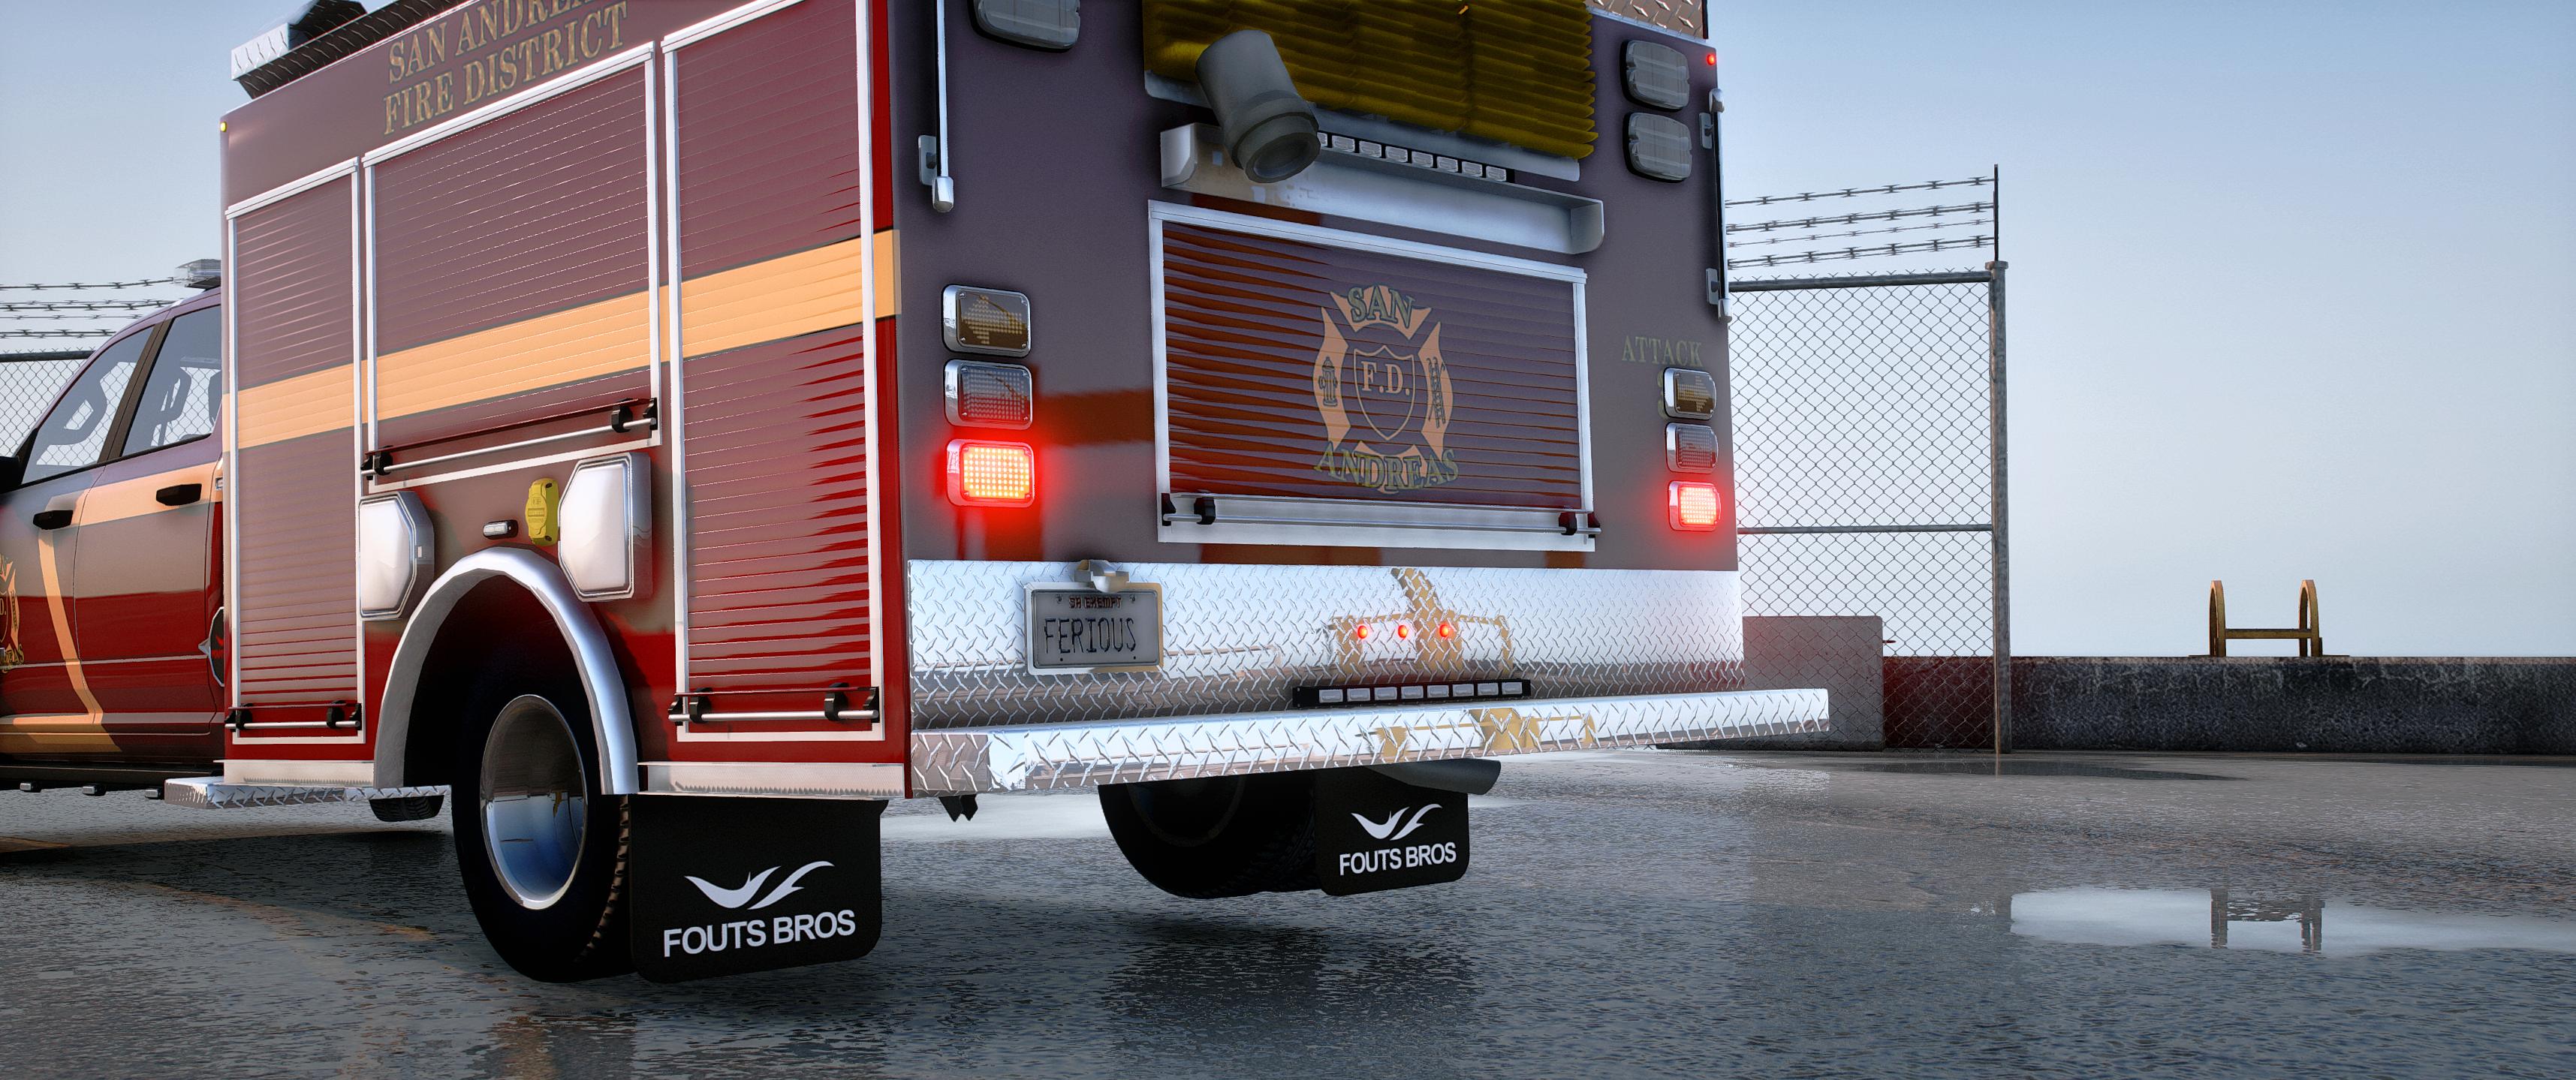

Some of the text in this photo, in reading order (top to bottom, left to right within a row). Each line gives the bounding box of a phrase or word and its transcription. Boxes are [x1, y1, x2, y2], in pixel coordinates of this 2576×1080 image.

[383, 2, 628, 135] FIRE DISTRICT
[388, 21, 447, 84] SAN
[1347, 284, 1415, 329] SAN
[1622, 335, 1703, 367] ATTACK
[1360, 360, 1410, 396] F.D.
[1315, 441, 1459, 489] ANDREAS
[1044, 617, 1136, 654] FERIOUS
[1339, 842, 1457, 876] FOUTS BROS
[664, 910, 856, 958] FOUTS BROS
